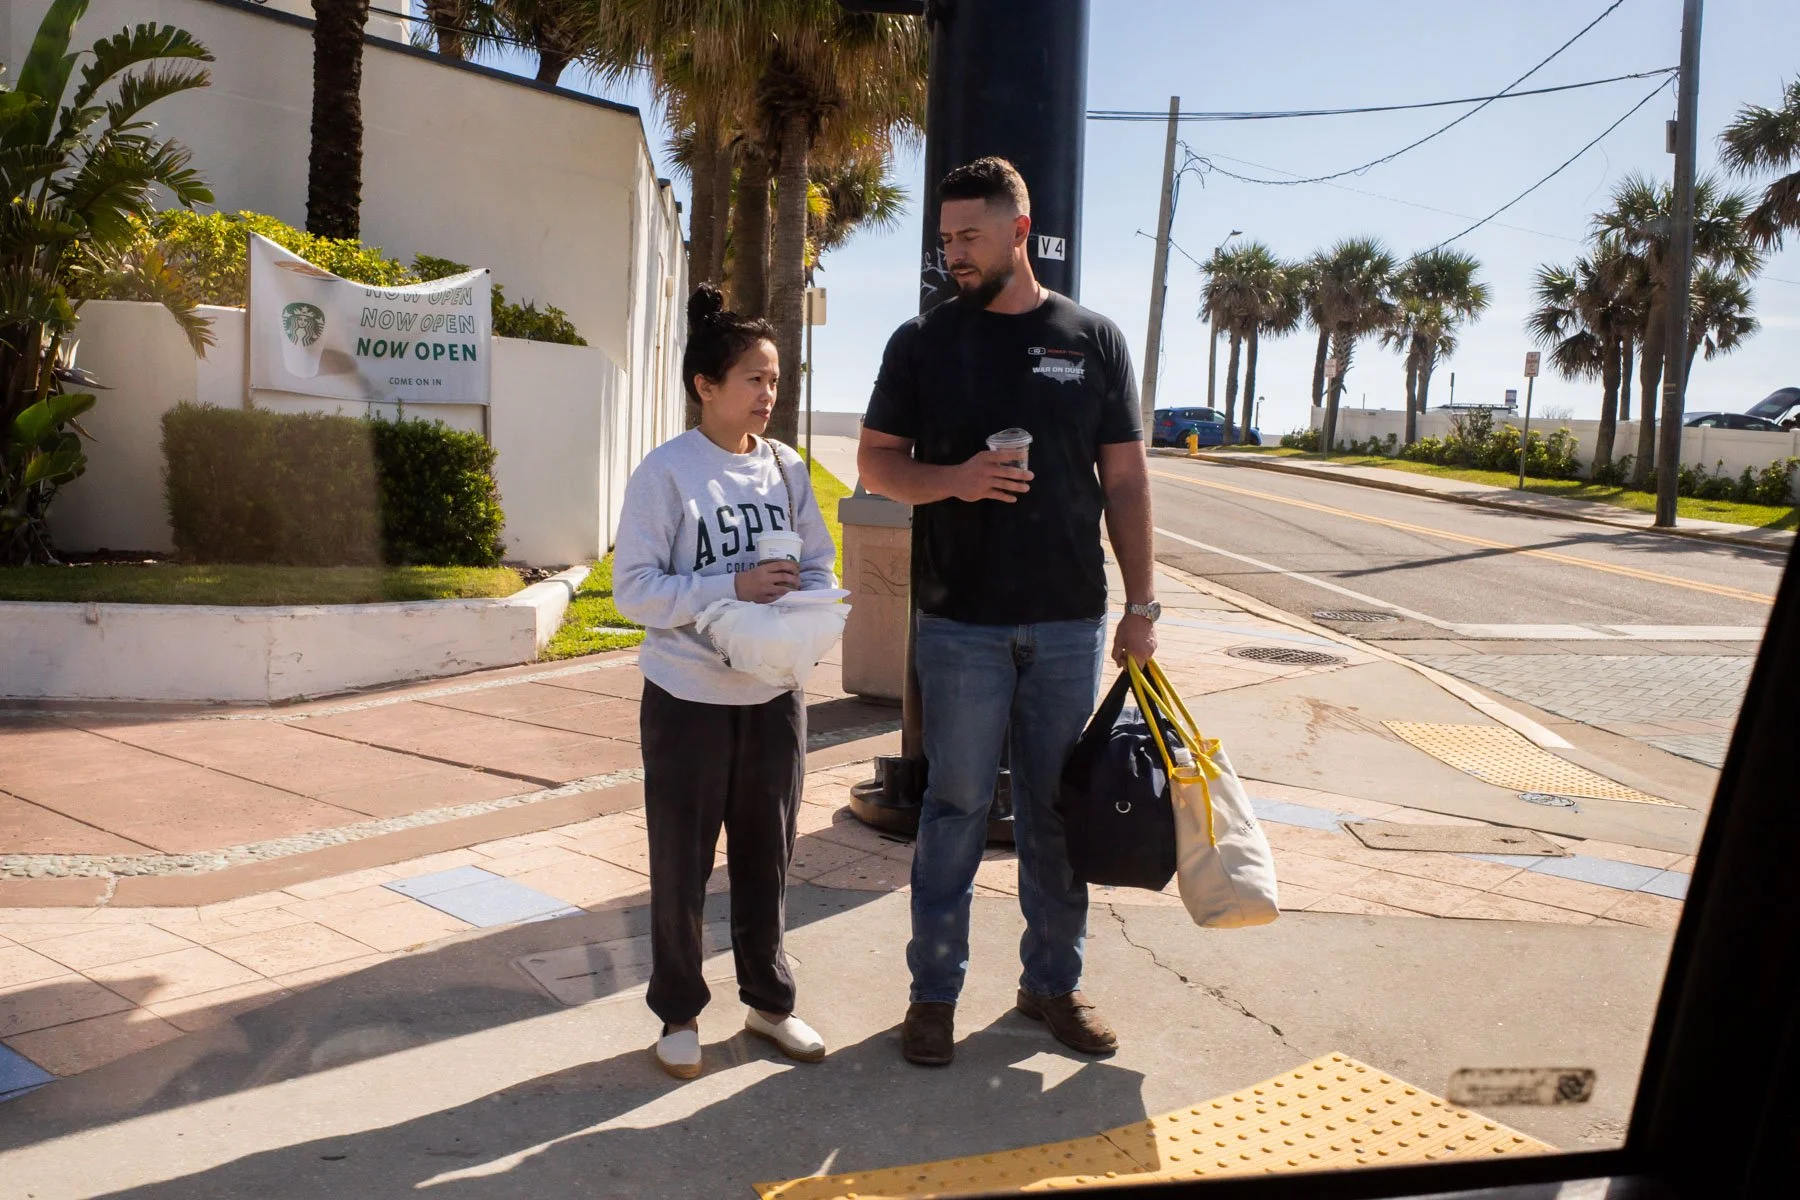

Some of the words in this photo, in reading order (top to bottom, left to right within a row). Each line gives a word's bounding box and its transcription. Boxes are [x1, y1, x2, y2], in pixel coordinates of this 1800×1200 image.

[1041, 237, 1051, 255] V
[1055, 239, 1063, 256] 4
[428, 287, 473, 305] OPEN
[361, 307, 418, 331] NOW
[420, 313, 475, 334] OPEN
[356, 337, 410, 359] NOW
[415, 341, 477, 361] OPEN
[1032, 366, 1051, 374] WAR
[1065, 367, 1085, 375] DUST
[389, 376, 413, 386] COME
[416, 378, 430, 386] ON
[432, 378, 442, 386] IN
[693, 503, 785, 572] ASPE
[726, 562, 756, 573] COLO
